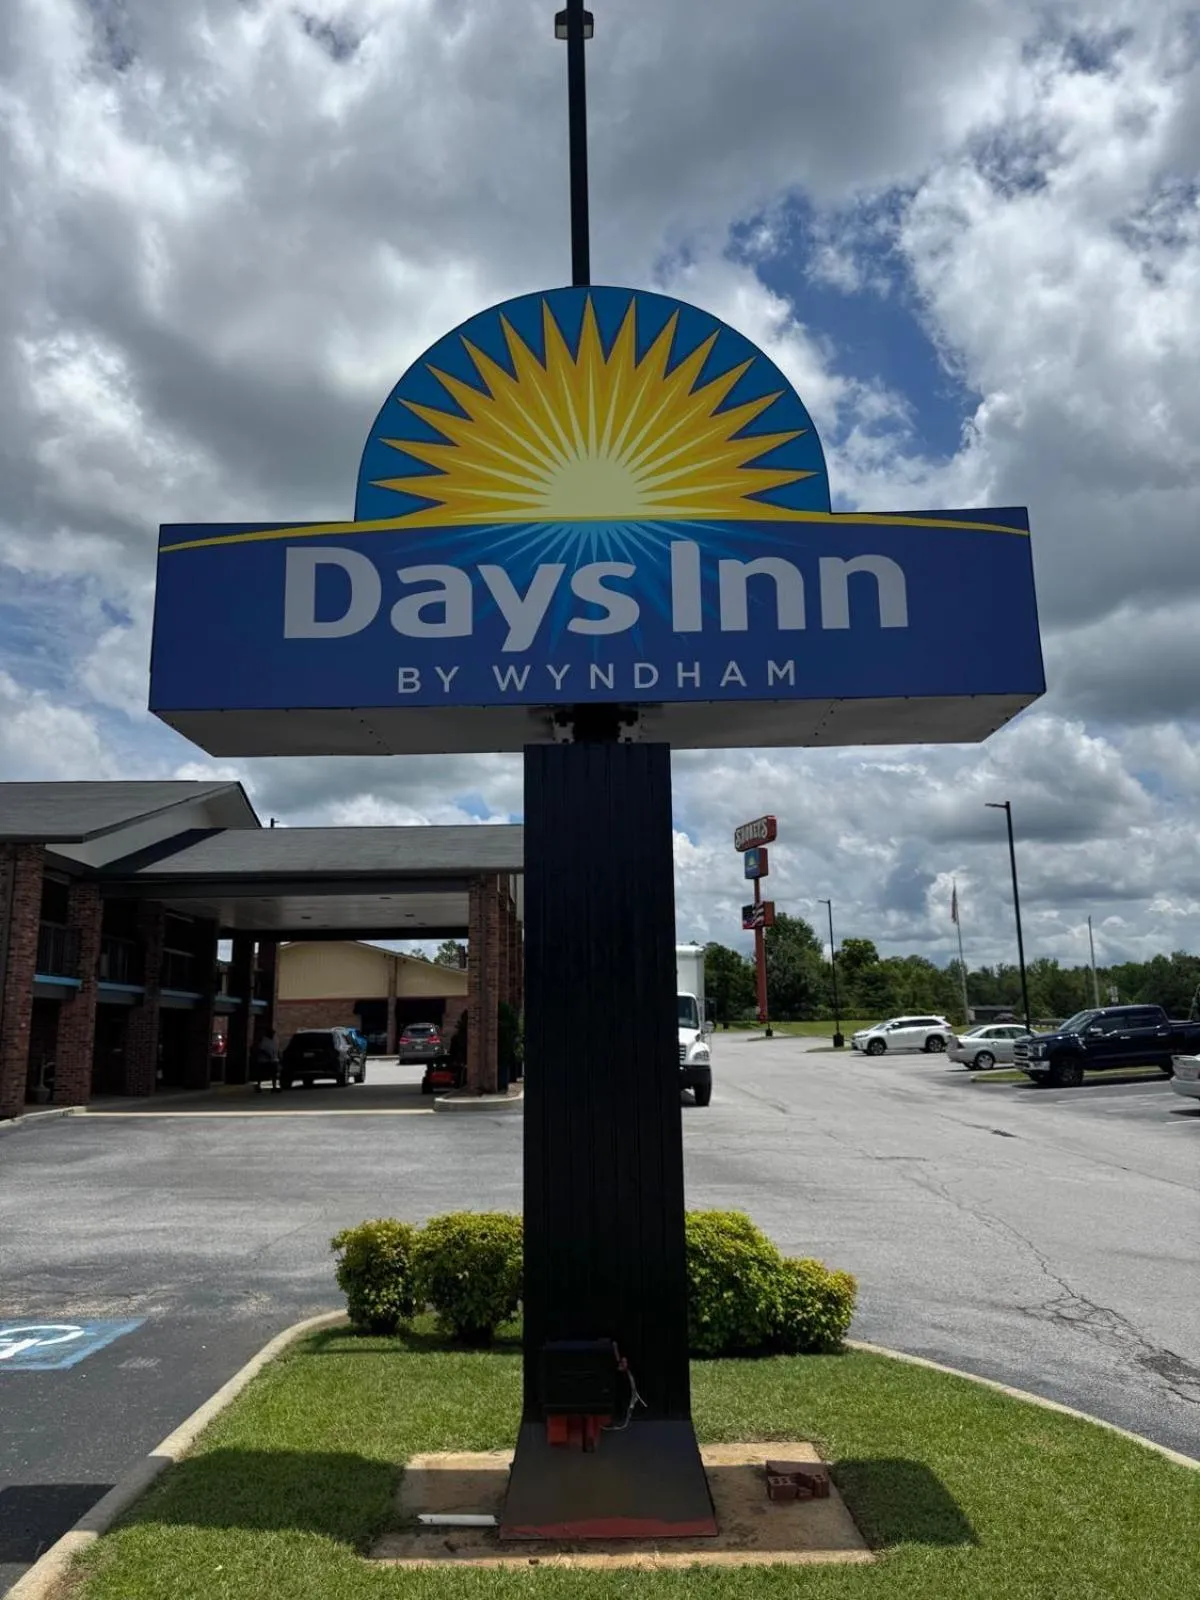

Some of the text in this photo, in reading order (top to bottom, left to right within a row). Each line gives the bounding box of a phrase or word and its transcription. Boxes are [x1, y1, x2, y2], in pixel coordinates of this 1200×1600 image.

[284, 540, 909, 653] Days Inn
[396, 659, 797, 694] BY WYNDHAM
